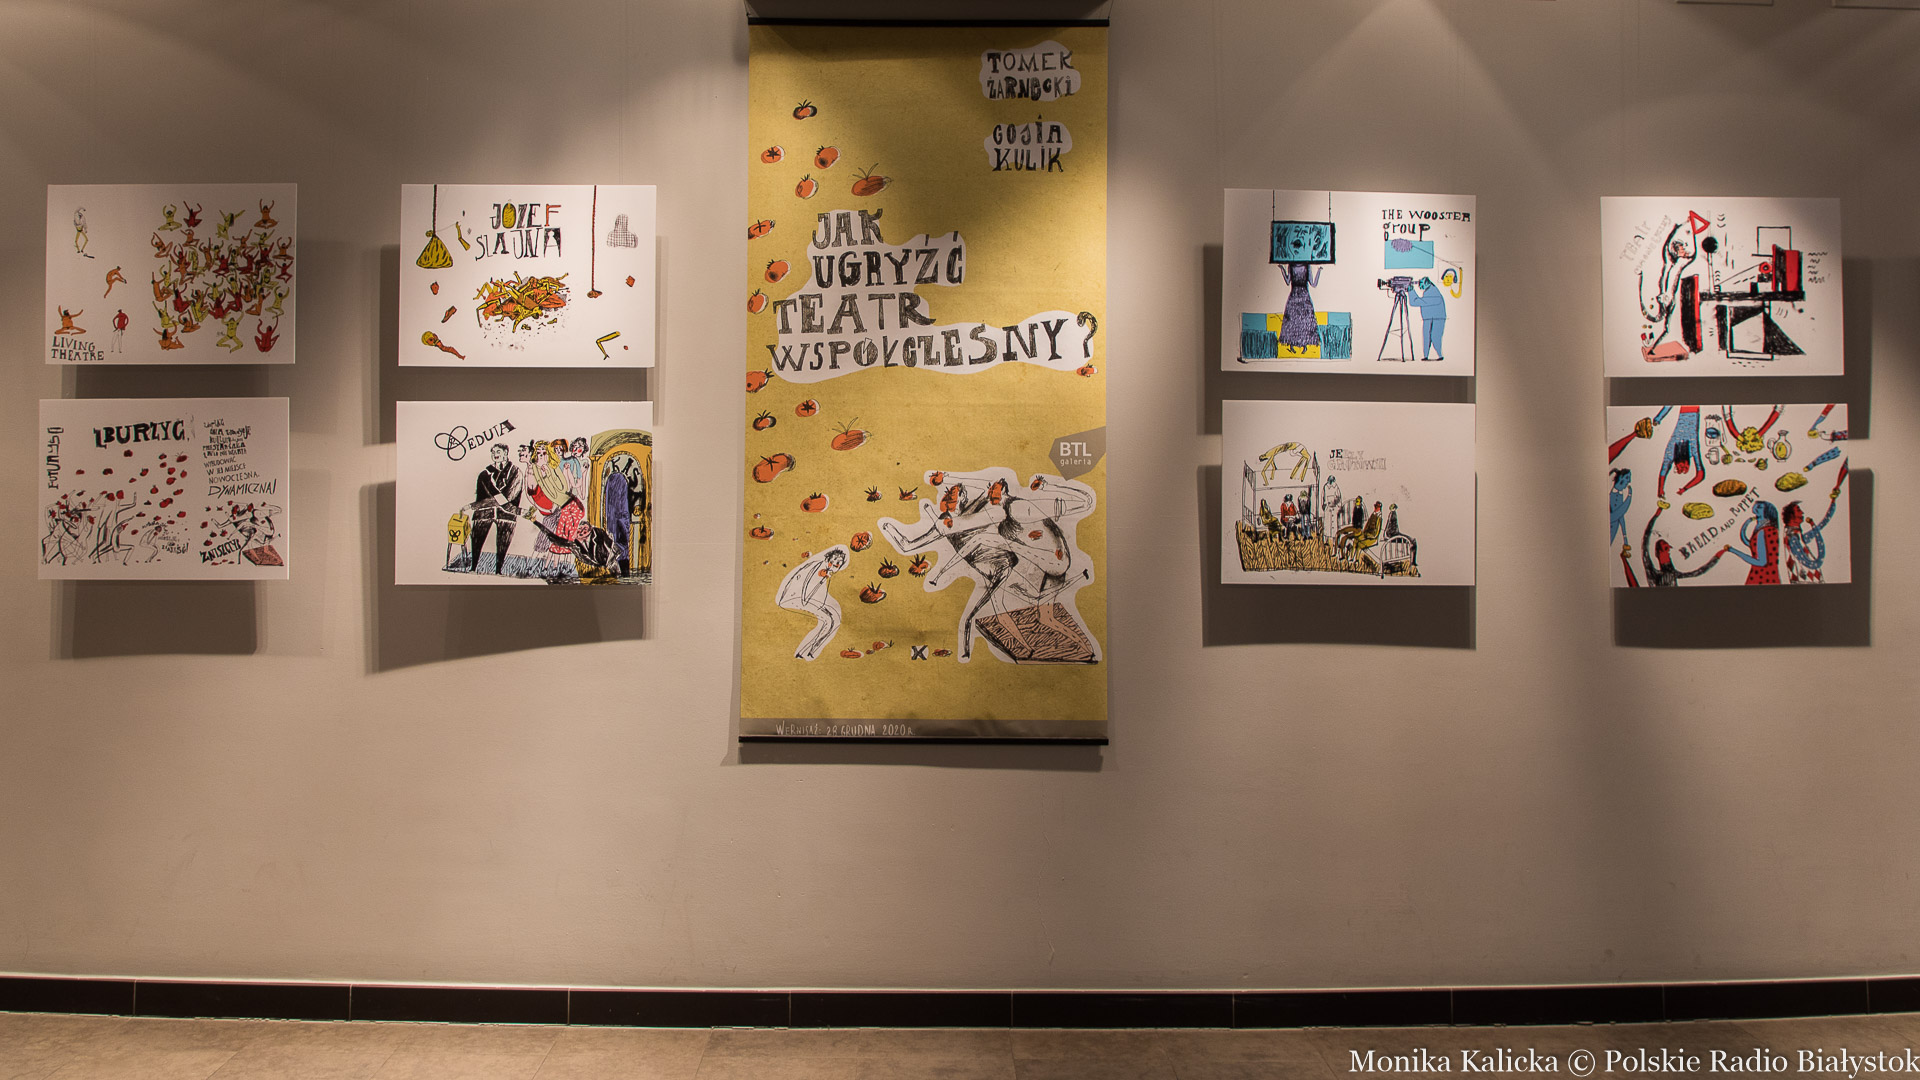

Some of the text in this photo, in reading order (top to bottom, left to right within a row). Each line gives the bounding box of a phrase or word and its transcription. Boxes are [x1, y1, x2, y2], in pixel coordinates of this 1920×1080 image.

[986, 50, 1075, 73] TOMEK
[992, 145, 1064, 172] KULIK
[1382, 208, 1471, 222] THE WOOSTER
[812, 208, 884, 250] JAK
[812, 230, 964, 289] UGRYŹĆ
[772, 292, 937, 335] TEATR
[52, 335, 96, 353] LIVING
[51, 348, 105, 361] THEATRE
[1060, 441, 1092, 457] BTL
[1060, 458, 1092, 467] galeria
[206, 468, 215, 476] W
[1719, 518, 1736, 533] AND
[1729, 486, 1760, 517] PUPPET
[882, 723, 906, 736] 2020
